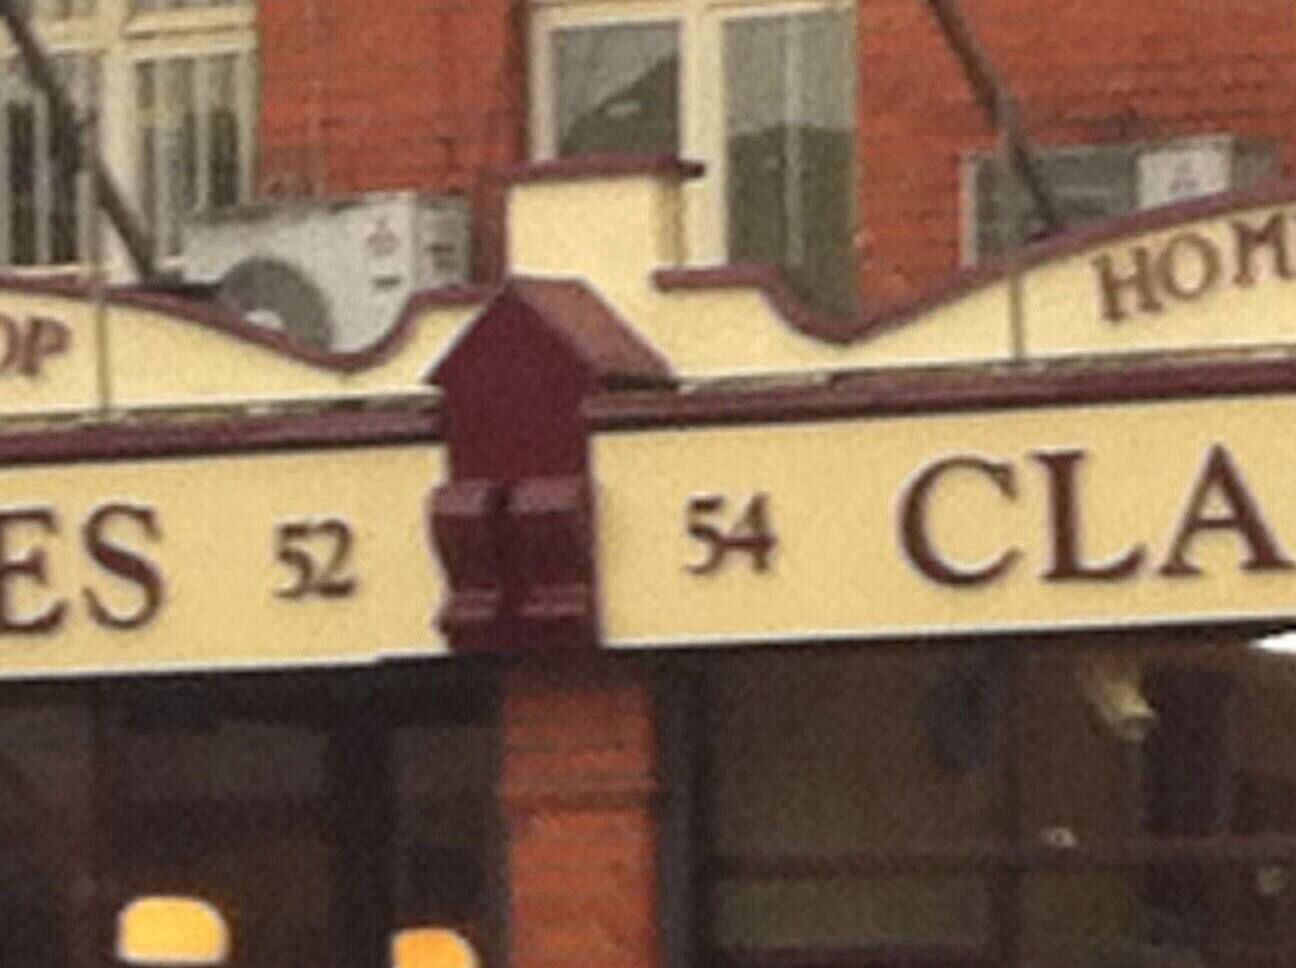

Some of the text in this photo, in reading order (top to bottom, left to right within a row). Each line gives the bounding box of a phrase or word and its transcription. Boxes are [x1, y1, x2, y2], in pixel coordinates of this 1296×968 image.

[0, 503, 360, 639] ES 52
[686, 494, 779, 577] 54
